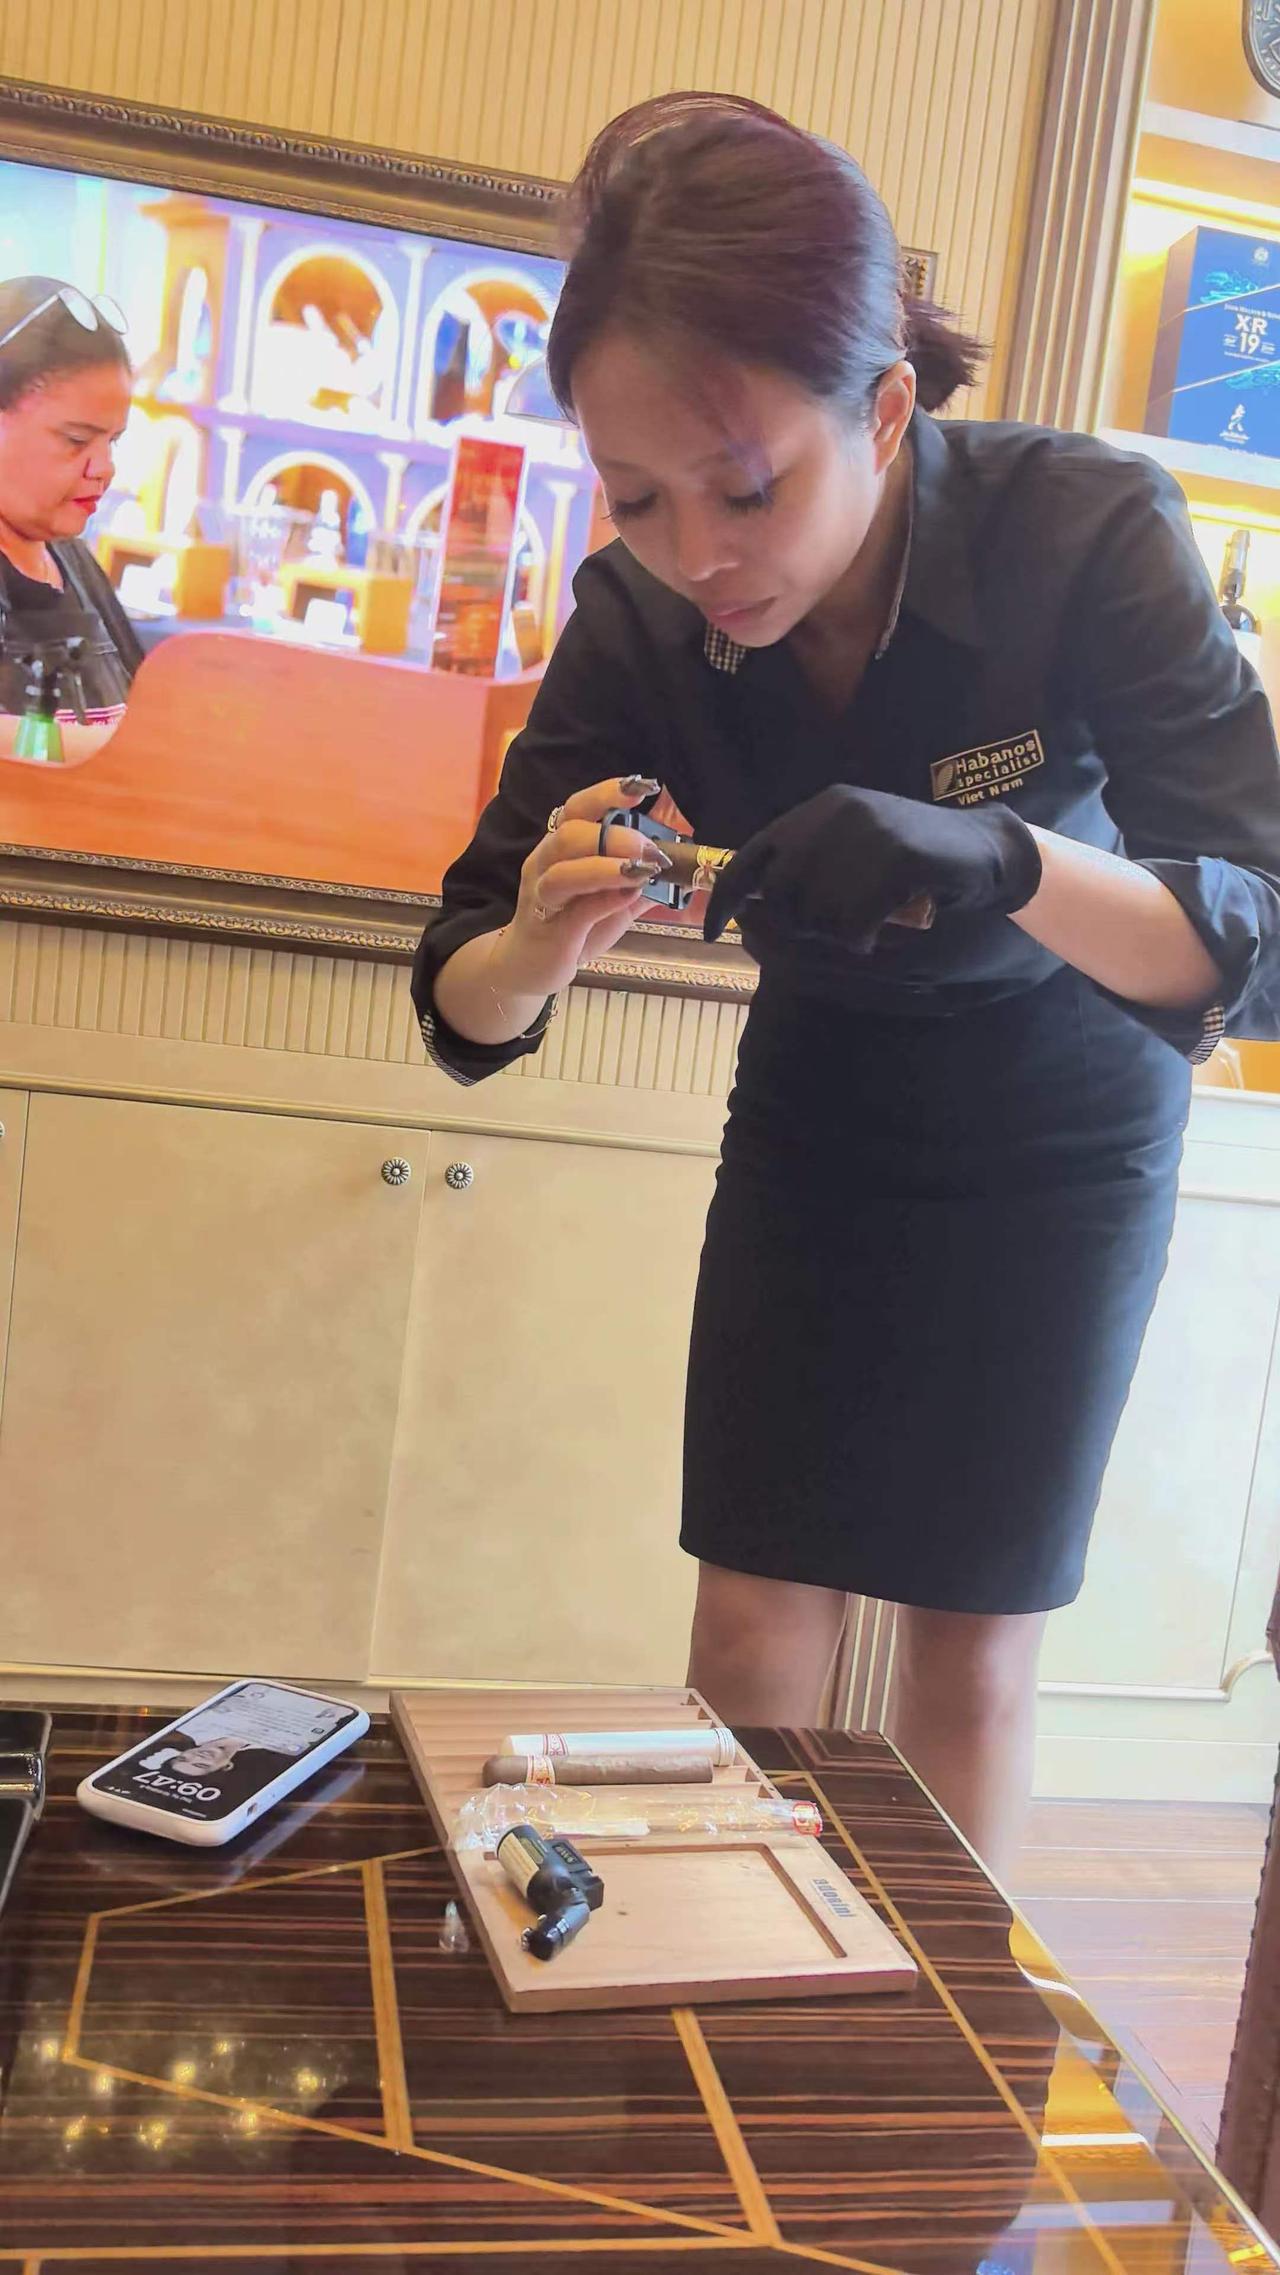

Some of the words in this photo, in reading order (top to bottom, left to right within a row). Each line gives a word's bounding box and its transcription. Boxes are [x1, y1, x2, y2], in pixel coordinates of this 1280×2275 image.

[1235, 314, 1268, 335] XR
[1240, 332, 1260, 354] 19
[955, 739, 1036, 775] Habanos
[957, 789, 985, 806] Viet
[989, 777, 1024, 797] Nam
[132, 1770, 221, 1801] 09:47
